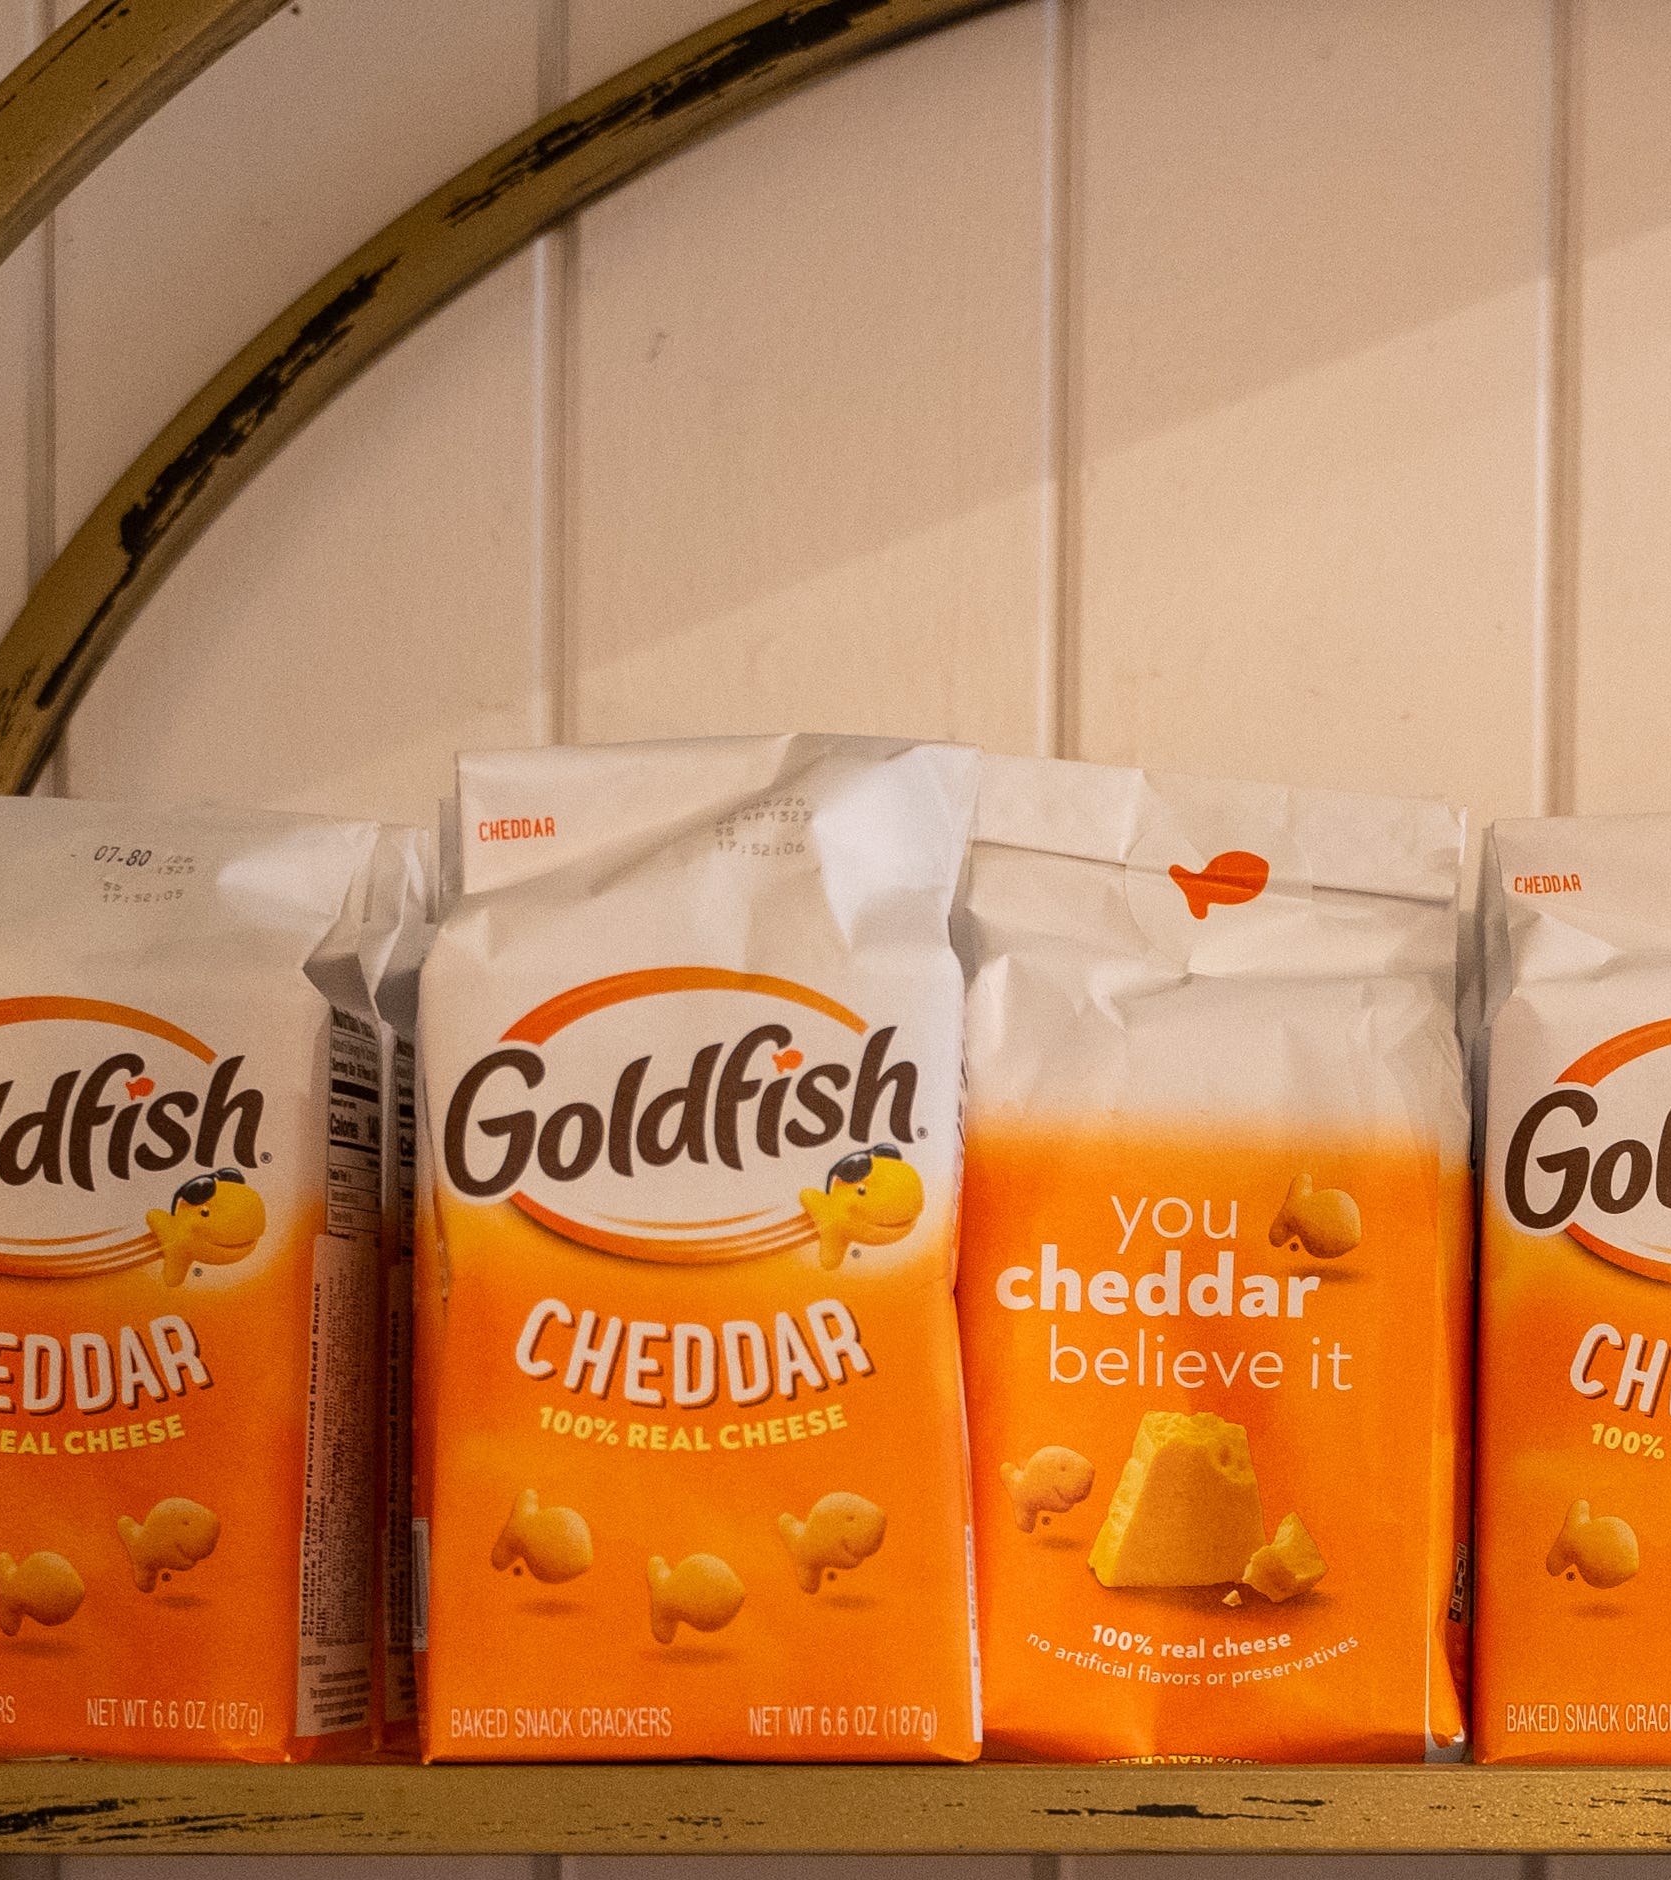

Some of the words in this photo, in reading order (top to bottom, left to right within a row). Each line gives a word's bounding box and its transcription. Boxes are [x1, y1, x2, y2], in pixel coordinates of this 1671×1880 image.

[479, 817, 555, 841] CHEDDAR
[1514, 874, 1582, 894] CHEDDAR
[445, 1025, 918, 1197] Goldfish
[1111, 1195, 1238, 1254] you
[995, 1244, 1321, 1318] cheddar
[516, 1299, 873, 1407] CHEDDAR
[1050, 1325, 1283, 1389] believe
[1311, 1336, 1352, 1391] it
[65, 1415, 185, 1453] CHEESE
[1027, 1633, 1051, 1653] no
[1055, 1646, 1133, 1680] artificial
[1137, 1665, 1202, 1686] flavors
[1206, 1670, 1225, 1686] or
[1231, 1635, 1358, 1688] preservatives
[1092, 1624, 1154, 1656] 100%
[1161, 1637, 1206, 1658] real
[1212, 1632, 1291, 1657] cheese
[87, 1698, 117, 1725] NET
[123, 1699, 148, 1728] WT
[153, 1700, 180, 1727] 6.6
[185, 1701, 206, 1729] OZ
[212, 1701, 264, 1735] (187g)
